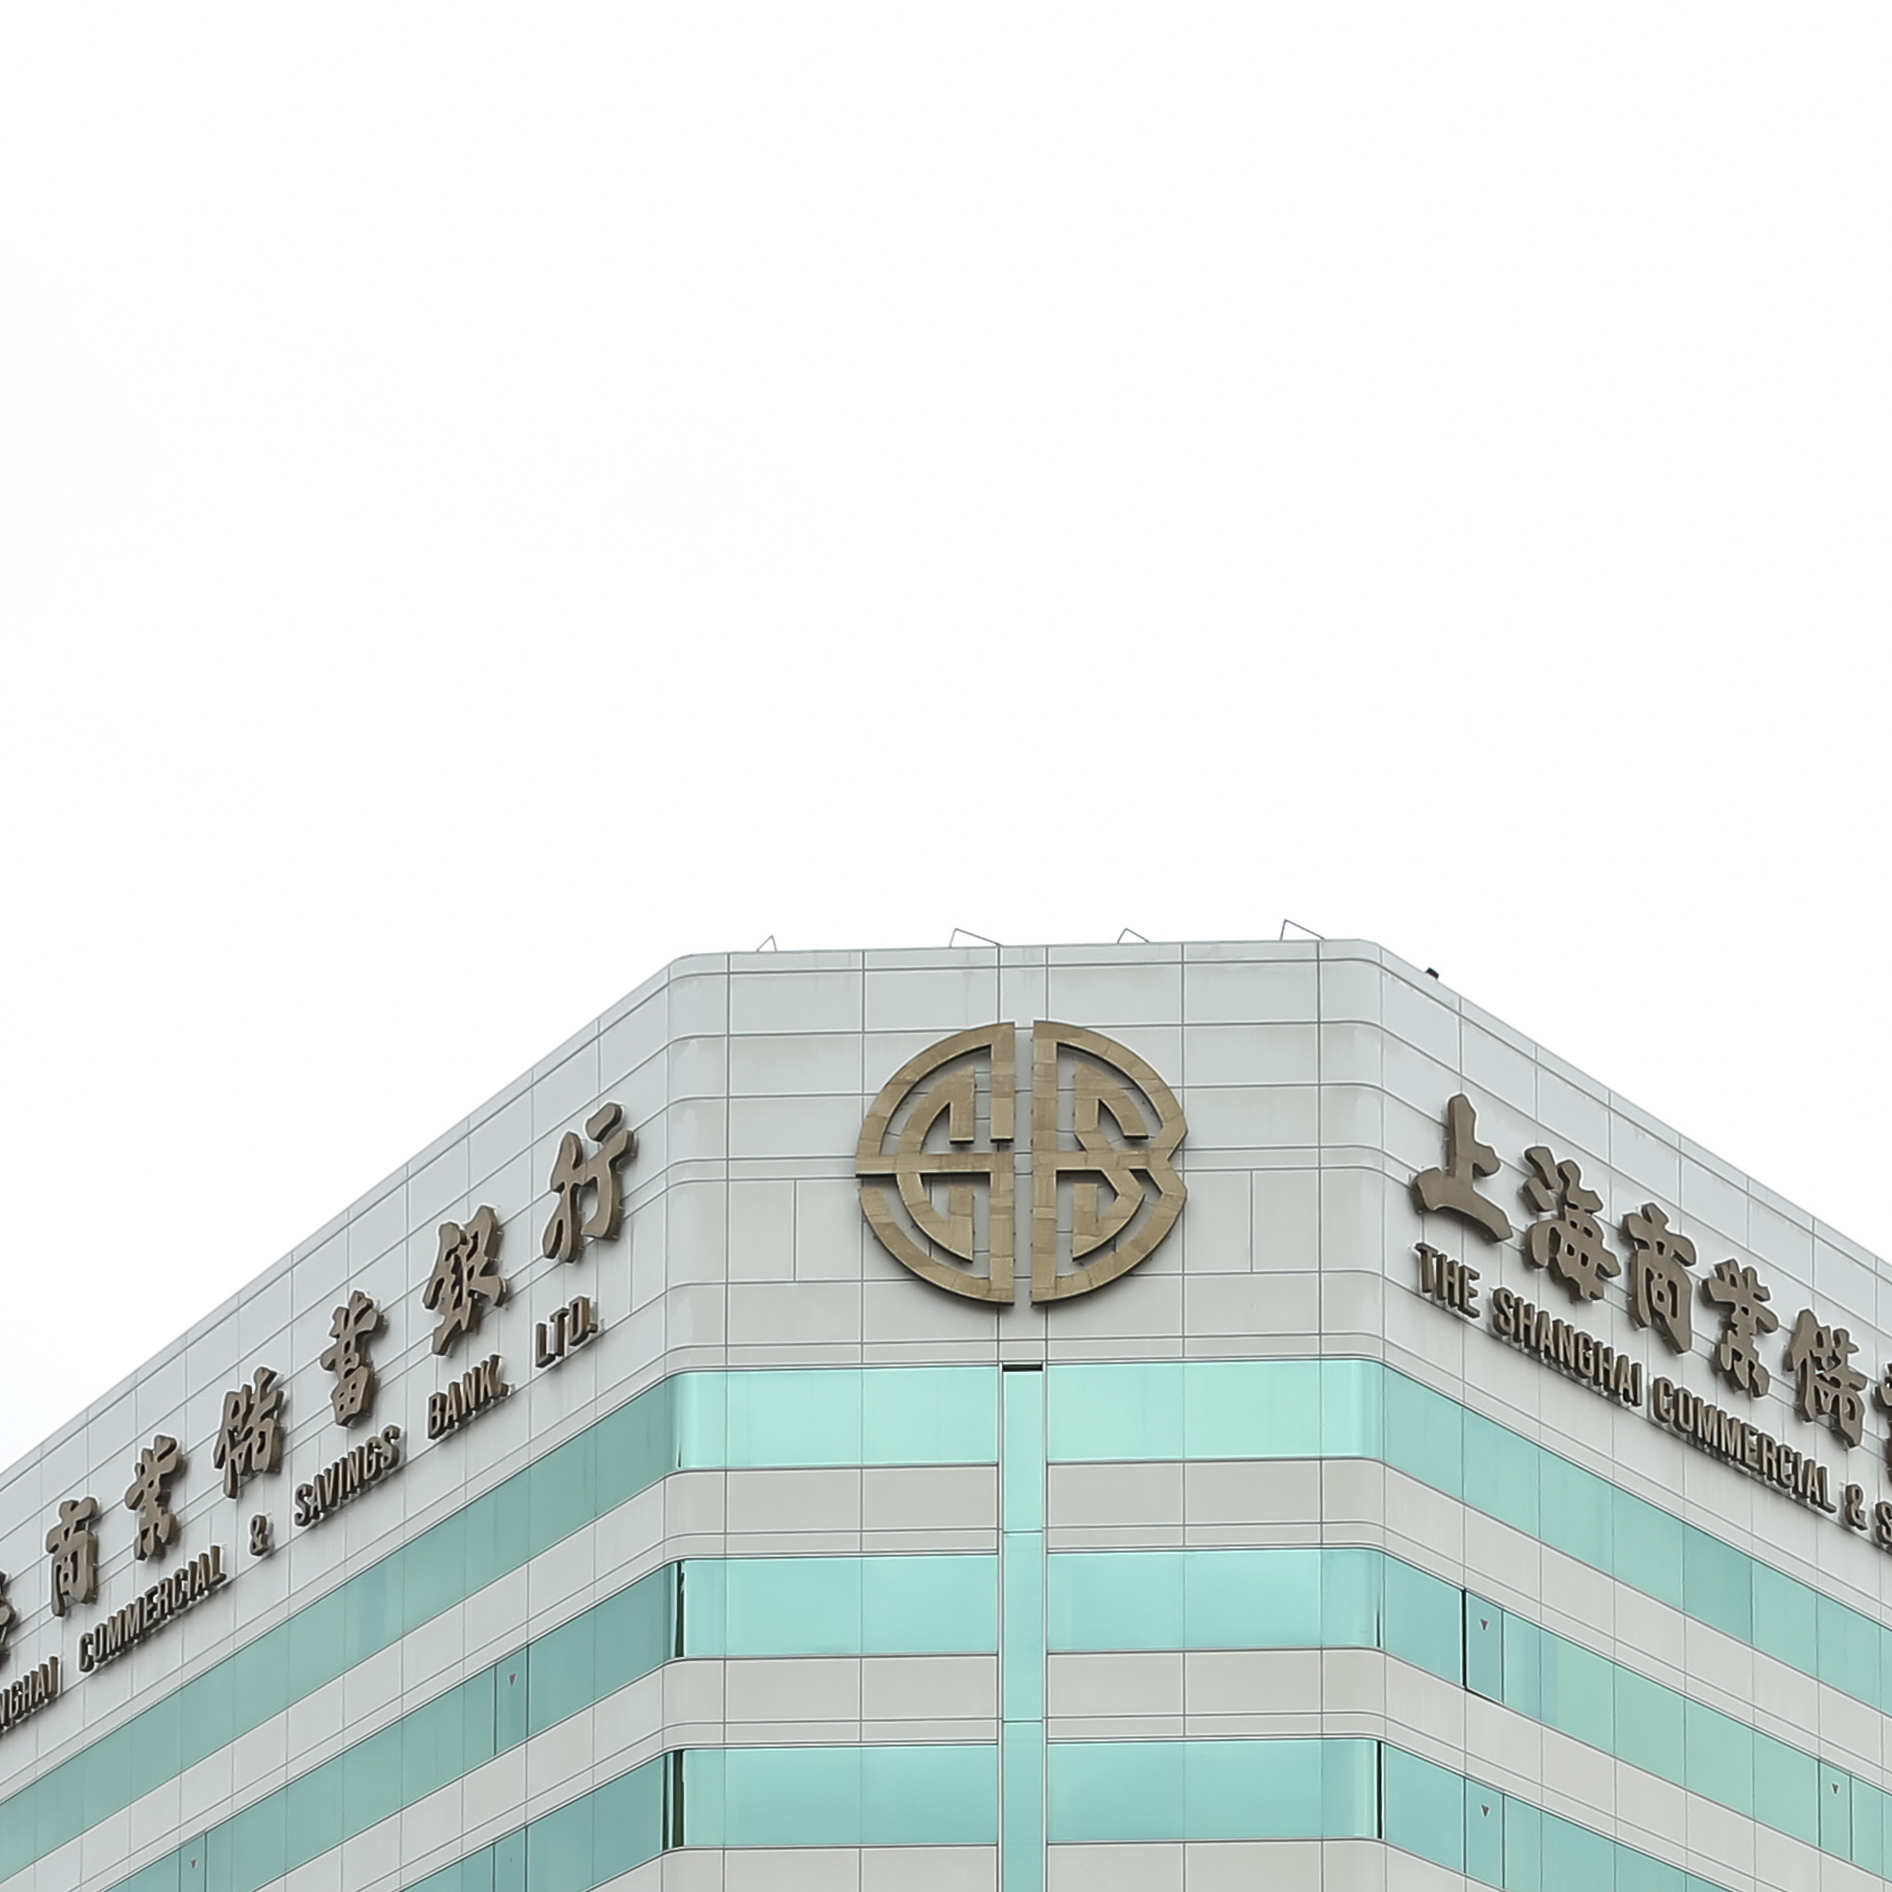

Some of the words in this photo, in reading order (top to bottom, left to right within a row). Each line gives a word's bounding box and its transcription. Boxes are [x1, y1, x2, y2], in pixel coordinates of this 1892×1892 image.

[78, 1545, 227, 1672] COMMERCIAL
[249, 1514, 271, 1556] &
[294, 1425, 402, 1526] SAVINGS
[535, 1295, 598, 1368] LTD.
[1415, 1242, 1480, 1318] THE
[1493, 1287, 1642, 1407] SHANGHAI
[1653, 1377, 1836, 1512] COMMERCIAL
[1846, 1484, 1867, 1531] &
